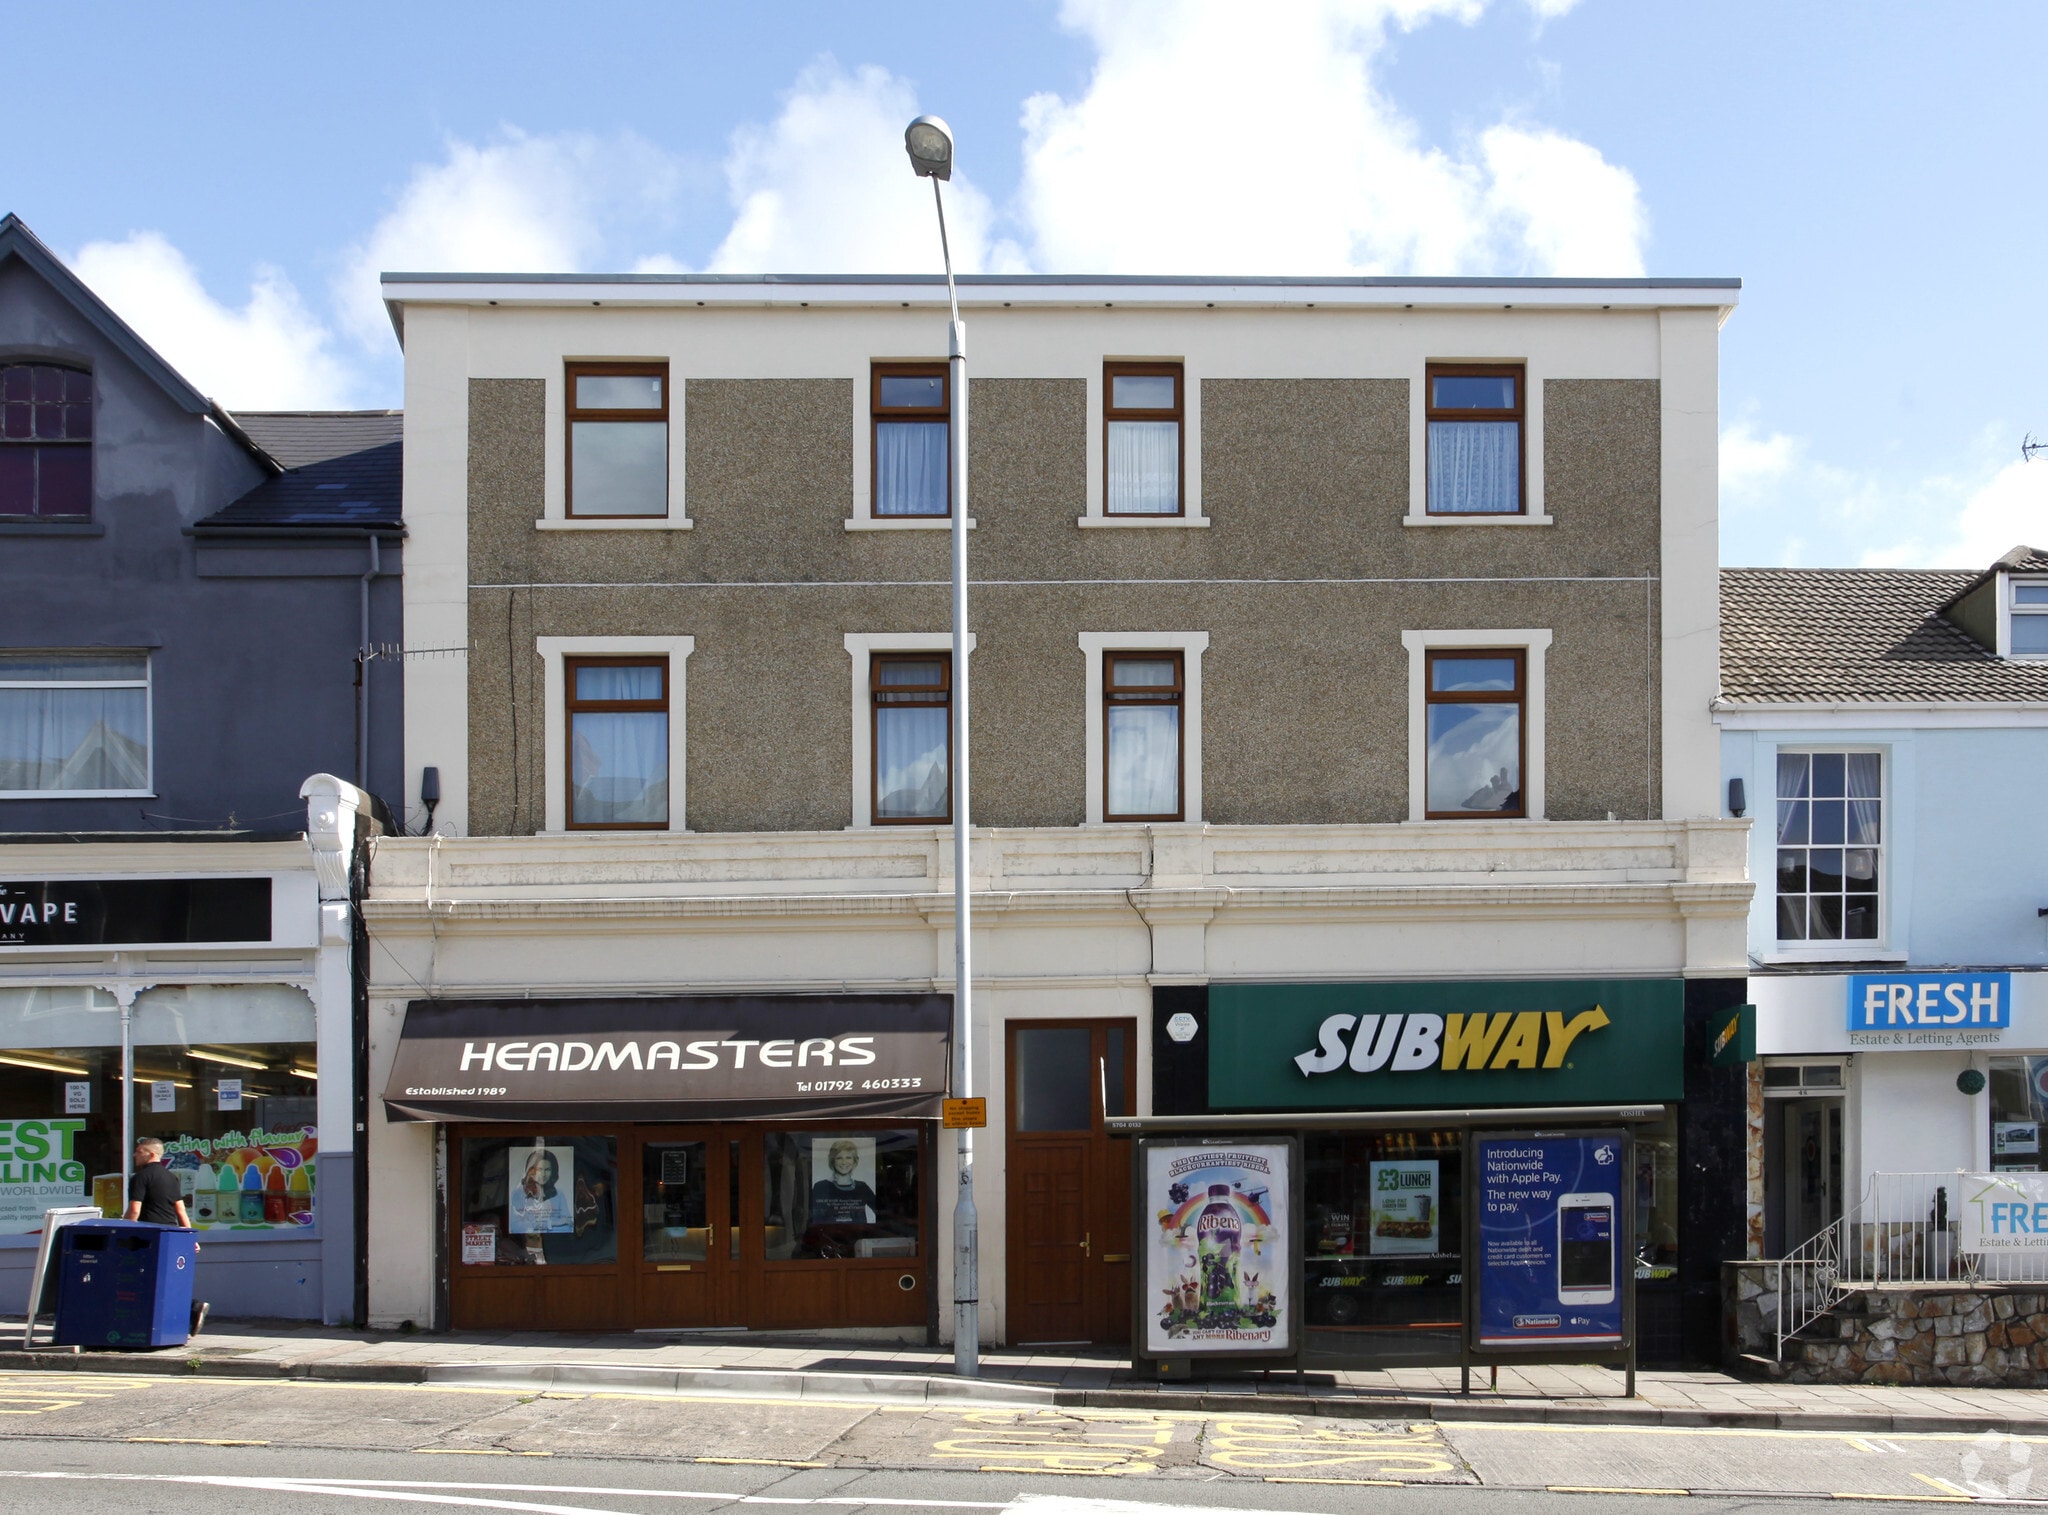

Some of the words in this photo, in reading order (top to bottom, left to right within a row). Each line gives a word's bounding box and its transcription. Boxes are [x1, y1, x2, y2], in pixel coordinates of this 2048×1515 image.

[0, 903, 78, 924] VAPE
[1864, 982, 1999, 1025] FRESH
[1294, 1004, 1611, 1078] SUBWAY
[1713, 1012, 1740, 1058] SUBWAY
[1850, 1033, 1890, 1046] Estate
[1894, 1033, 1903, 1044] &
[1908, 1032, 1952, 1046] Letting
[1956, 1032, 2000, 1046] Agents
[459, 1037, 877, 1071] HEADMASTERS
[405, 1087, 475, 1096] Established
[477, 1087, 507, 1096] 1989
[796, 1081, 811, 1092] Tel
[814, 1080, 854, 1092] 01792
[861, 1078, 922, 1090] 460333
[213, 1130, 248, 1150] with
[247, 1126, 306, 1148] flavour
[1487, 1148, 1544, 1160] Introducing
[1168, 1160, 1242, 1178] BLACKCURRANTIEST
[1171, 1158, 1189, 1168] THE
[1487, 1160, 1544, 1171] Nationwide
[0, 1162, 85, 1183] LING
[1487, 1173, 1509, 1184] with
[1511, 1173, 1540, 1185] Apple
[1543, 1172, 1562, 1184] Pay.
[1378, 1169, 1399, 1191] £3
[1400, 1173, 1431, 1187] LUNCH
[0, 1185, 83, 1196] WORLDWIDE
[1487, 1190, 1506, 1200] The
[1508, 1191, 1529, 1200] new
[1531, 1190, 1552, 1201] way
[1487, 1202, 1498, 1212] to
[1500, 1203, 1519, 1214] pay.
[1199, 1215, 1240, 1231] Ribena
[1991, 1202, 2048, 1234] FRE
[1980, 1237, 2011, 1247] Estate
[2013, 1237, 2021, 1247] &
[1319, 1276, 1366, 1287] SUBWAY
[1382, 1274, 1430, 1286] SUBWAY
[1525, 1317, 1559, 1326] Nationwide
[1578, 1317, 1590, 1326] Pay
[1226, 1329, 1271, 1343] Ribenary
